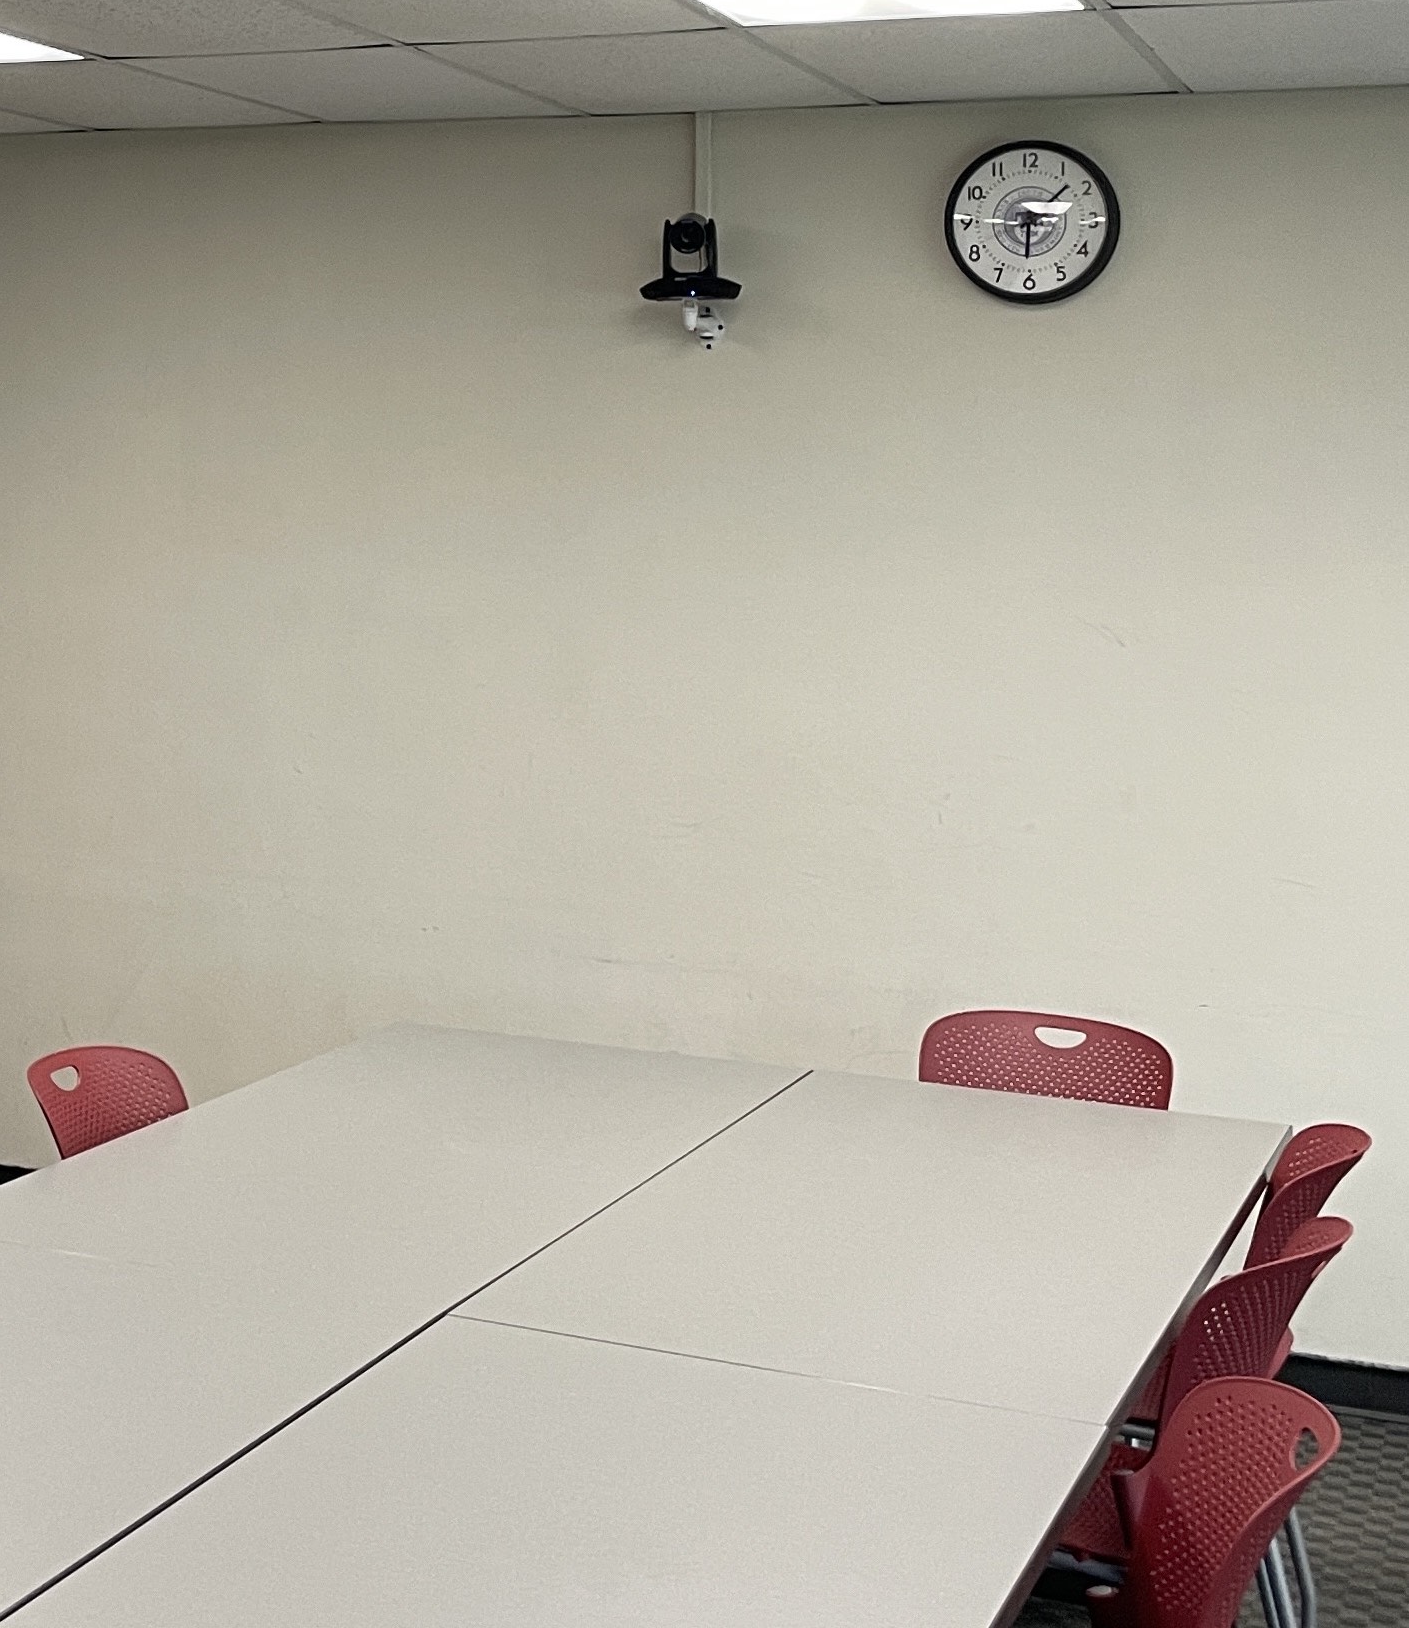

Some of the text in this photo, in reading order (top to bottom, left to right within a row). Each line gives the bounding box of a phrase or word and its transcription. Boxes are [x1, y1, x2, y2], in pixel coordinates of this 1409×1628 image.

[1022, 152, 1039, 168] 12
[991, 161, 1003, 177] 11
[967, 185, 983, 201] 10
[1081, 180, 1092, 196] 2
[1088, 212, 1099, 229] 3
[968, 244, 981, 262] 8
[1076, 240, 1089, 258] 4
[993, 267, 1003, 283] 7
[1022, 273, 1036, 290] 6
[1056, 265, 1067, 282] 5
